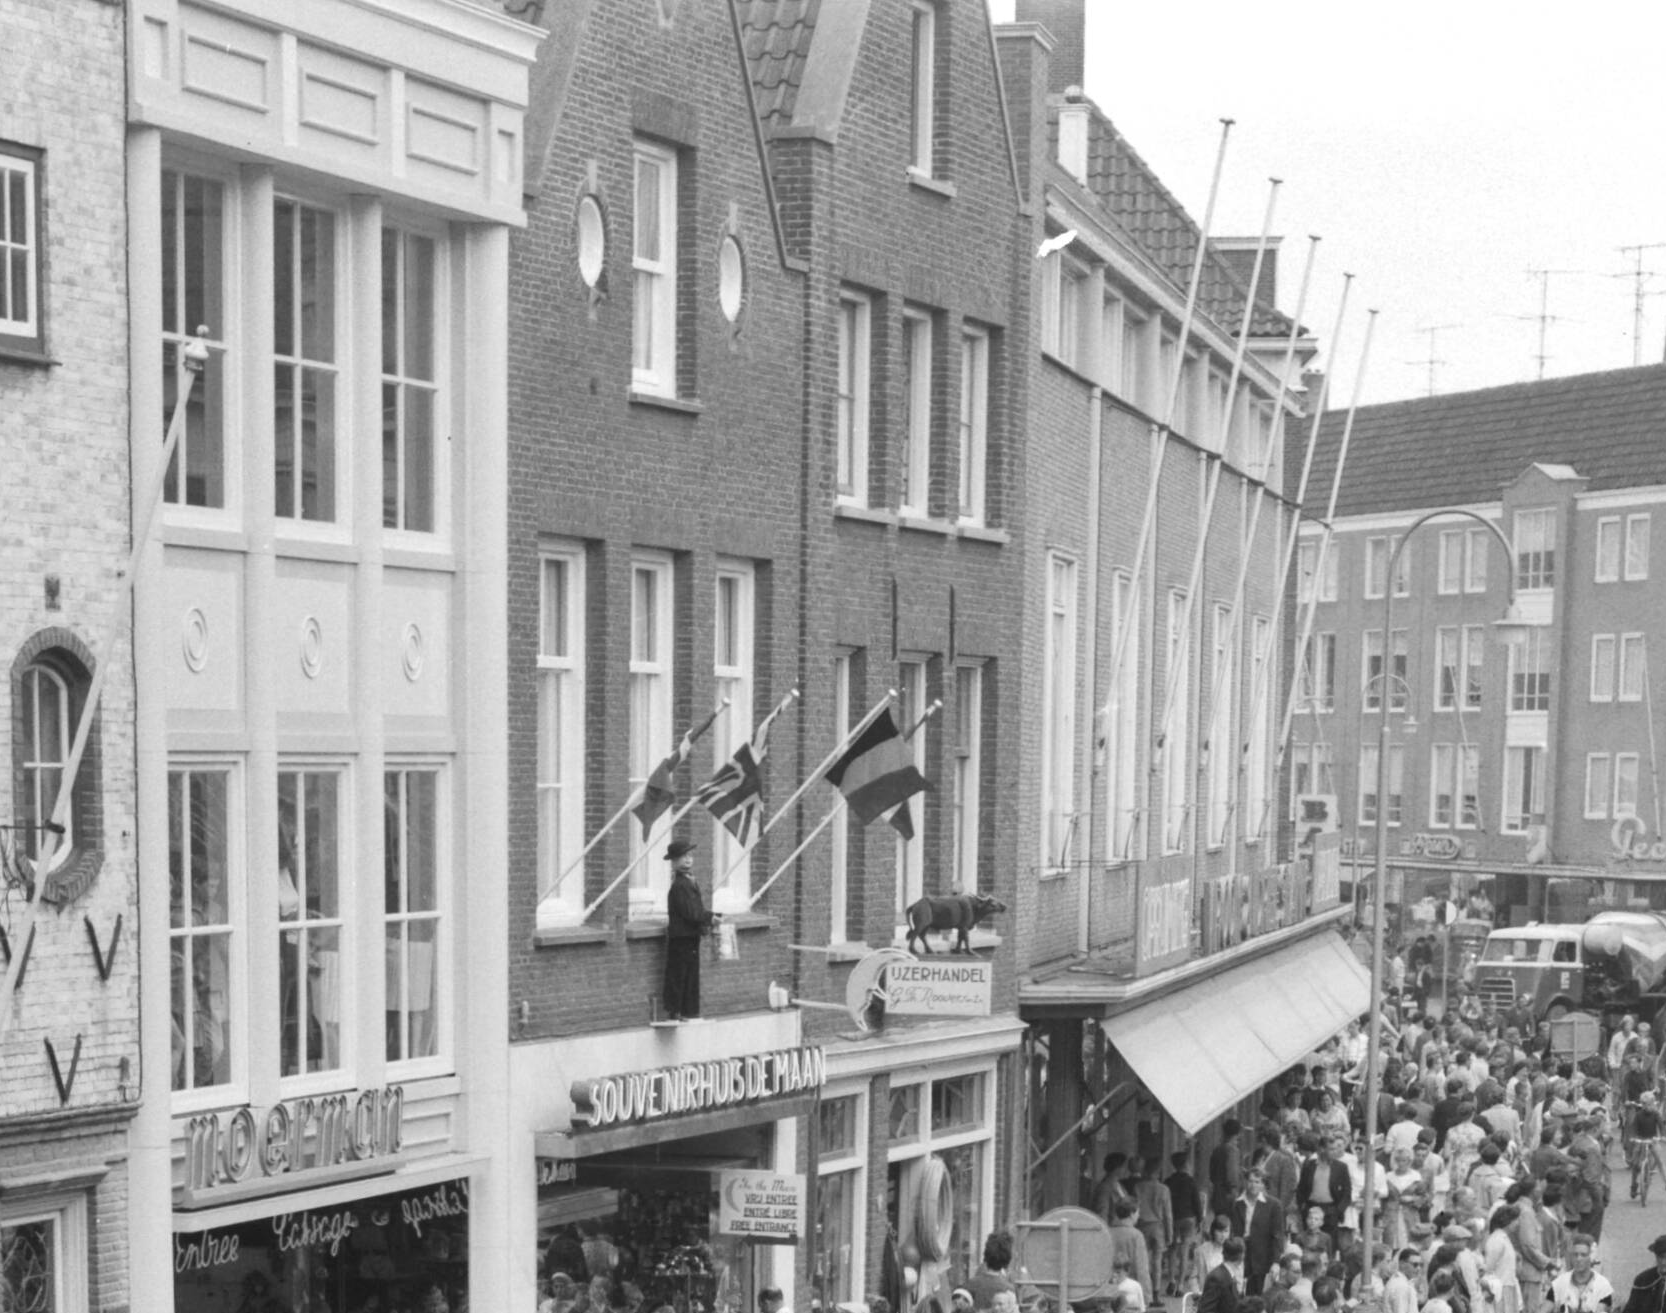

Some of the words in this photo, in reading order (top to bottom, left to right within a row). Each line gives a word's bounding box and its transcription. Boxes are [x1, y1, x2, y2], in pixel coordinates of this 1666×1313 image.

[588, 1058, 746, 1128] SOUVENIRHUIS
[746, 1055, 773, 1099] DE
[773, 1047, 827, 1094] MAAN
[754, 1221, 797, 1233] ENTRANCE
